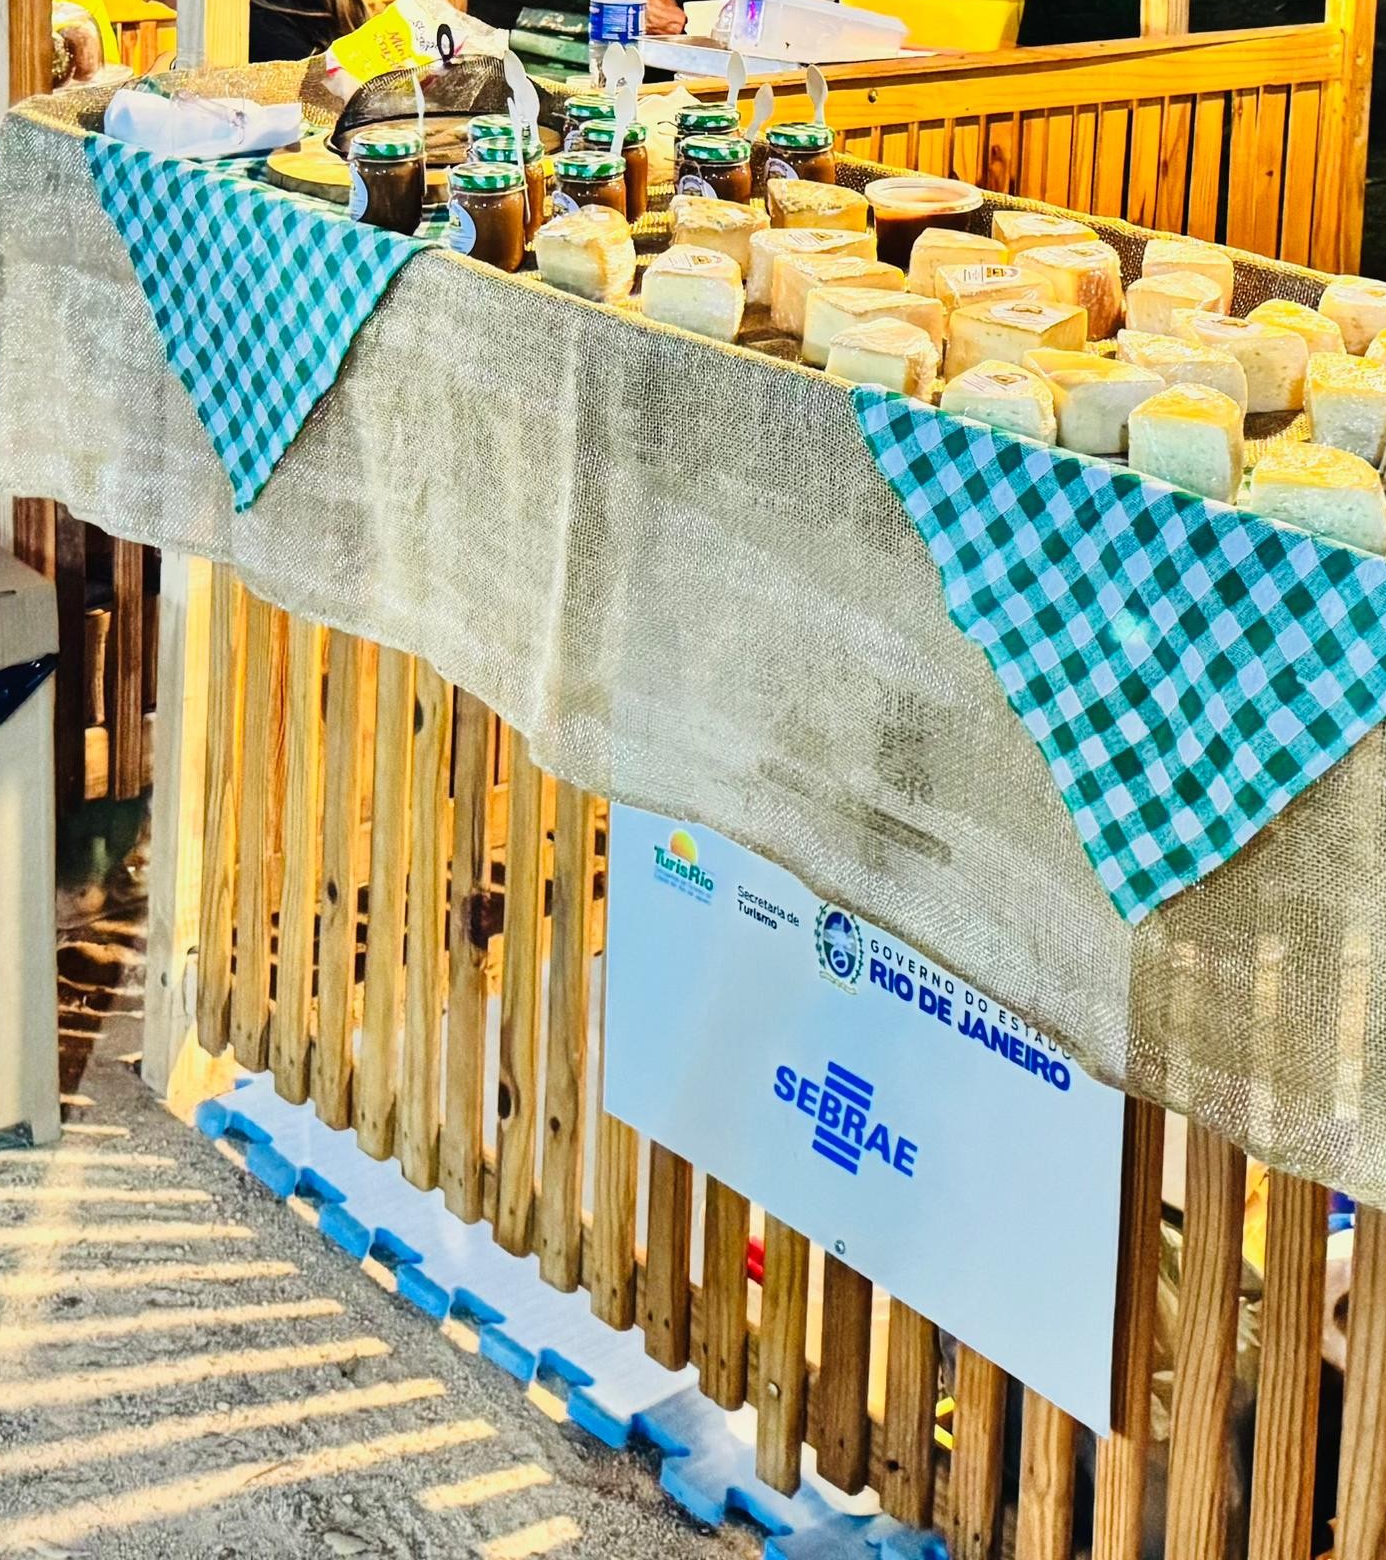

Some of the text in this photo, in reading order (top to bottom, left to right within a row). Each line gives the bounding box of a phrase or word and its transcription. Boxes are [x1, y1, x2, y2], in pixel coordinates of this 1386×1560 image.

[653, 844, 714, 892] TurisRio
[737, 885, 786, 920] Secretaria
[787, 911, 800, 927] de
[737, 899, 778, 930] Turismo
[870, 939, 955, 994] GOVERNO
[965, 990, 988, 1013] DO
[870, 958, 1072, 1092] RIO DE JANEIRO
[773, 1065, 919, 1178] SEBRAE
